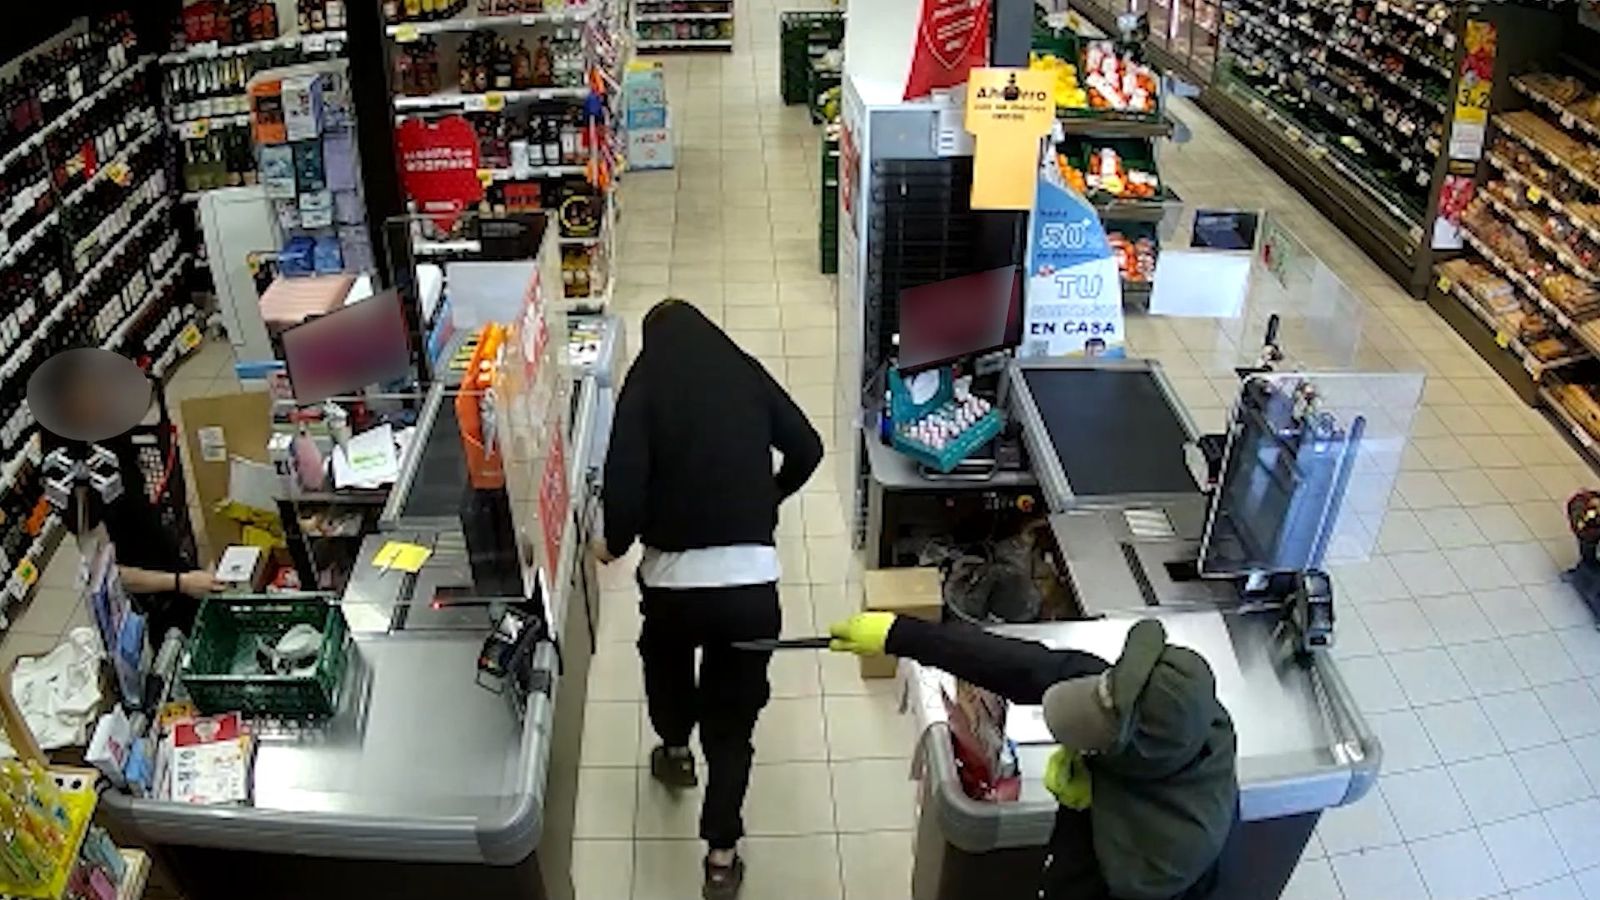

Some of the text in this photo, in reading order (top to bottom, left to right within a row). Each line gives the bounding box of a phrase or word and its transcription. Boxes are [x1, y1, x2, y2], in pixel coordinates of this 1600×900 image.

[1053, 274, 1103, 299] TU
[1031, 321, 1116, 336] EN CASA
